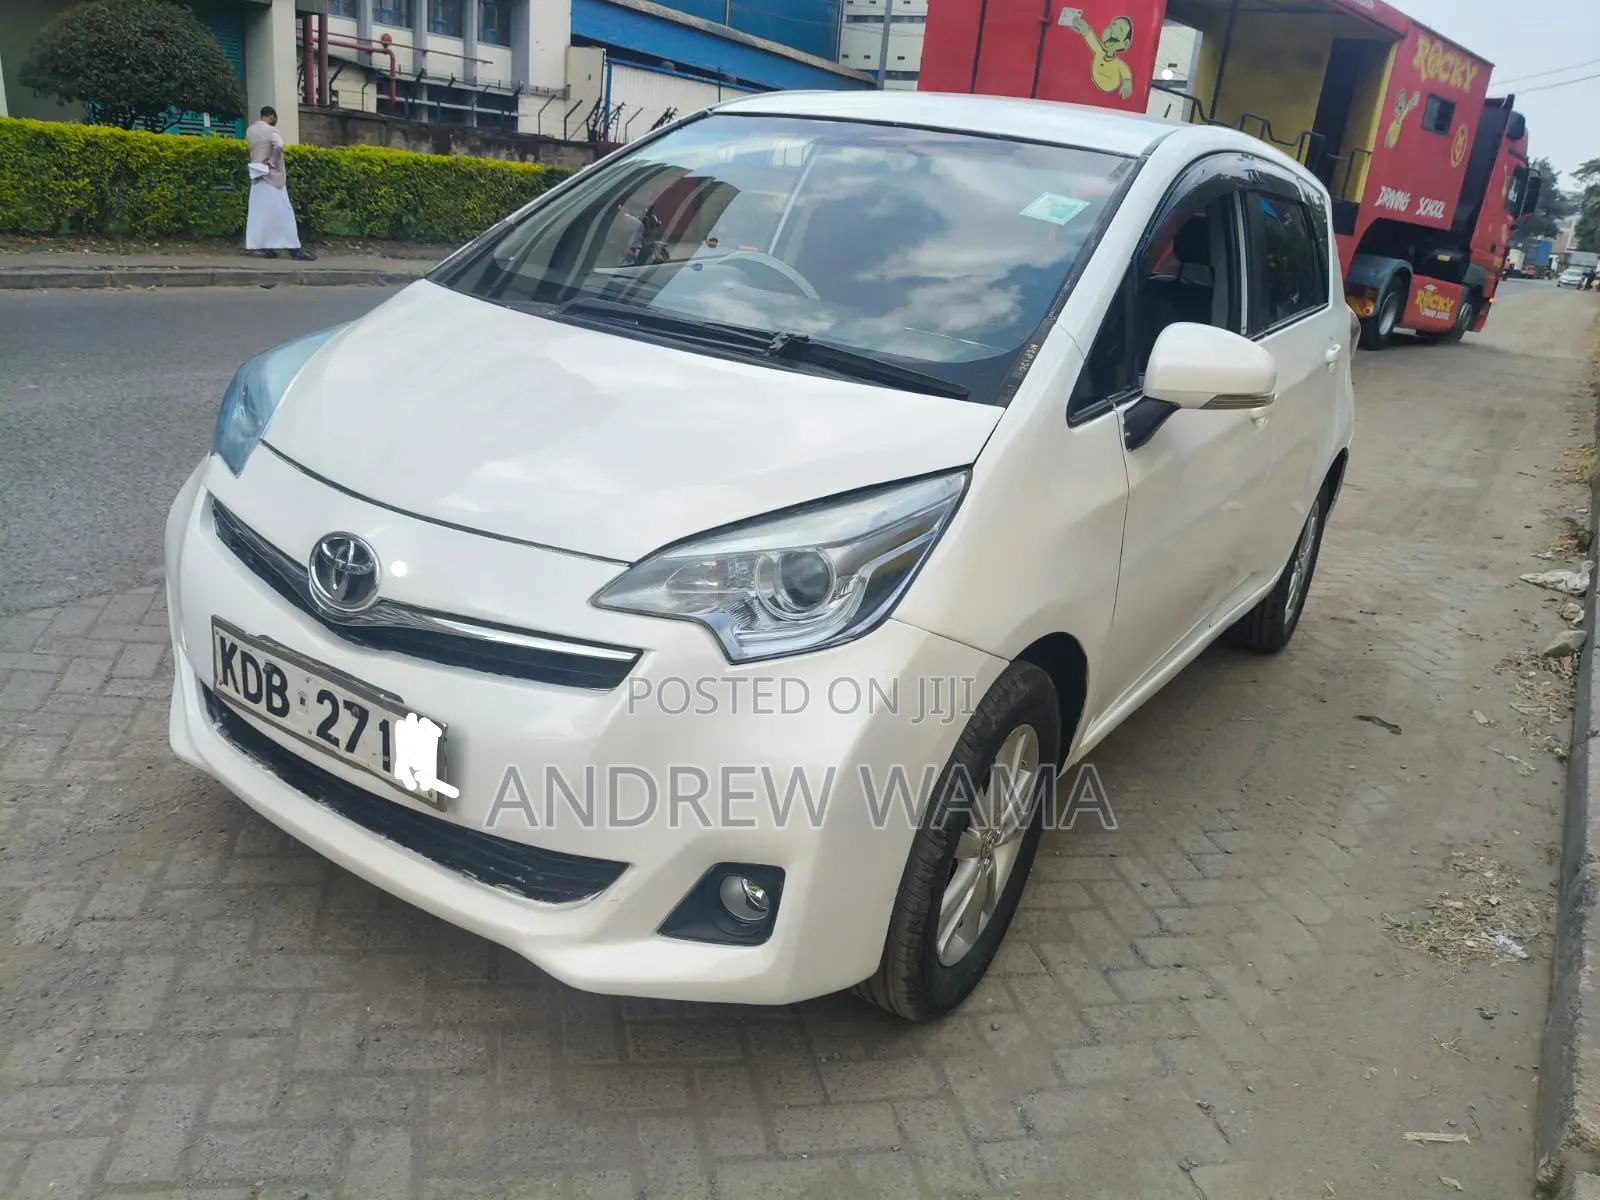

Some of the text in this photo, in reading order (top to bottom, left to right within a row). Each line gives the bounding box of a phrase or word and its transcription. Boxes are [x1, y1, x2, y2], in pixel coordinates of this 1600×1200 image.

[1412, 34, 1479, 93] ROCKY
[1374, 184, 1446, 219] DRIVING SCHOOL
[218, 636, 419, 777] KDB 271
